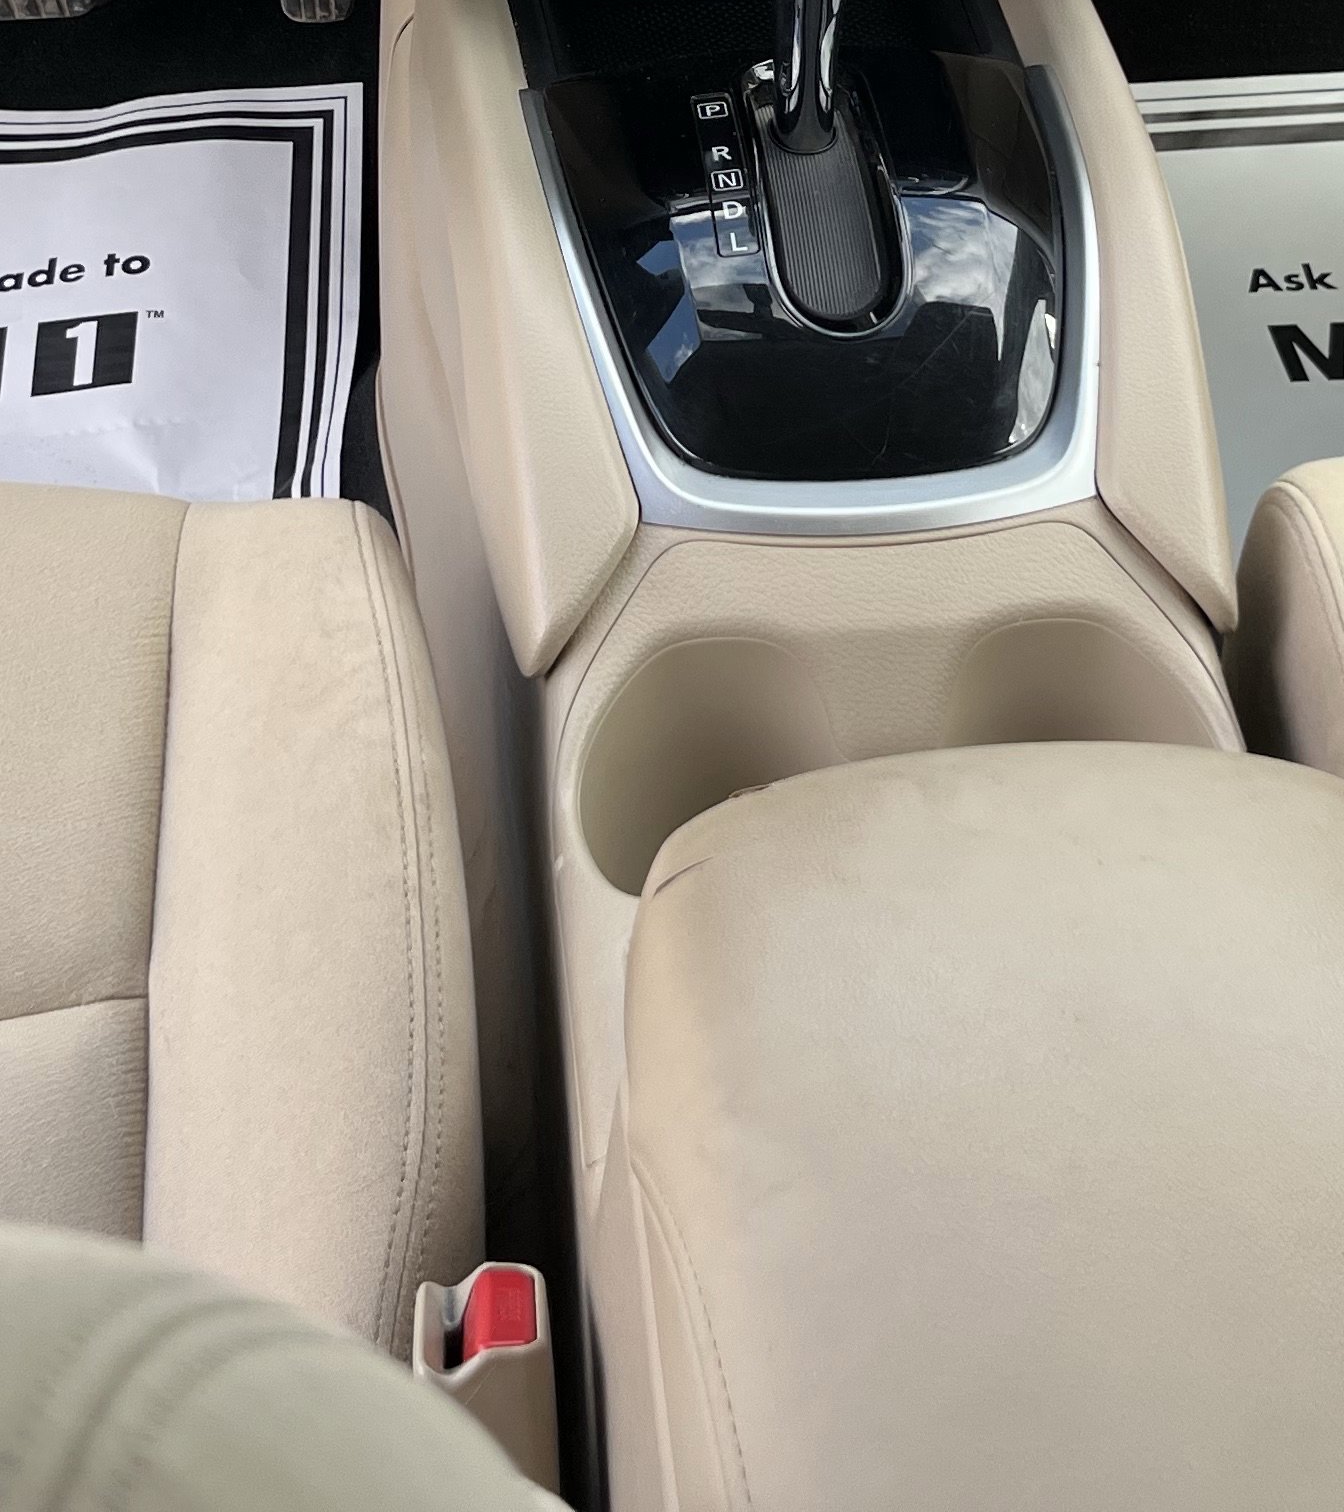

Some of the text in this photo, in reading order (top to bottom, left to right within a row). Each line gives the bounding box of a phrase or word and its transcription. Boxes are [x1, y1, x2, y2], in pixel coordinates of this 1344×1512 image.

[705, 105, 721, 117] P
[712, 146, 732, 161] R
[717, 172, 737, 188] N
[722, 201, 743, 220] D
[729, 232, 748, 252] L
[103, 252, 151, 277] to
[1248, 262, 1338, 294] Ask
